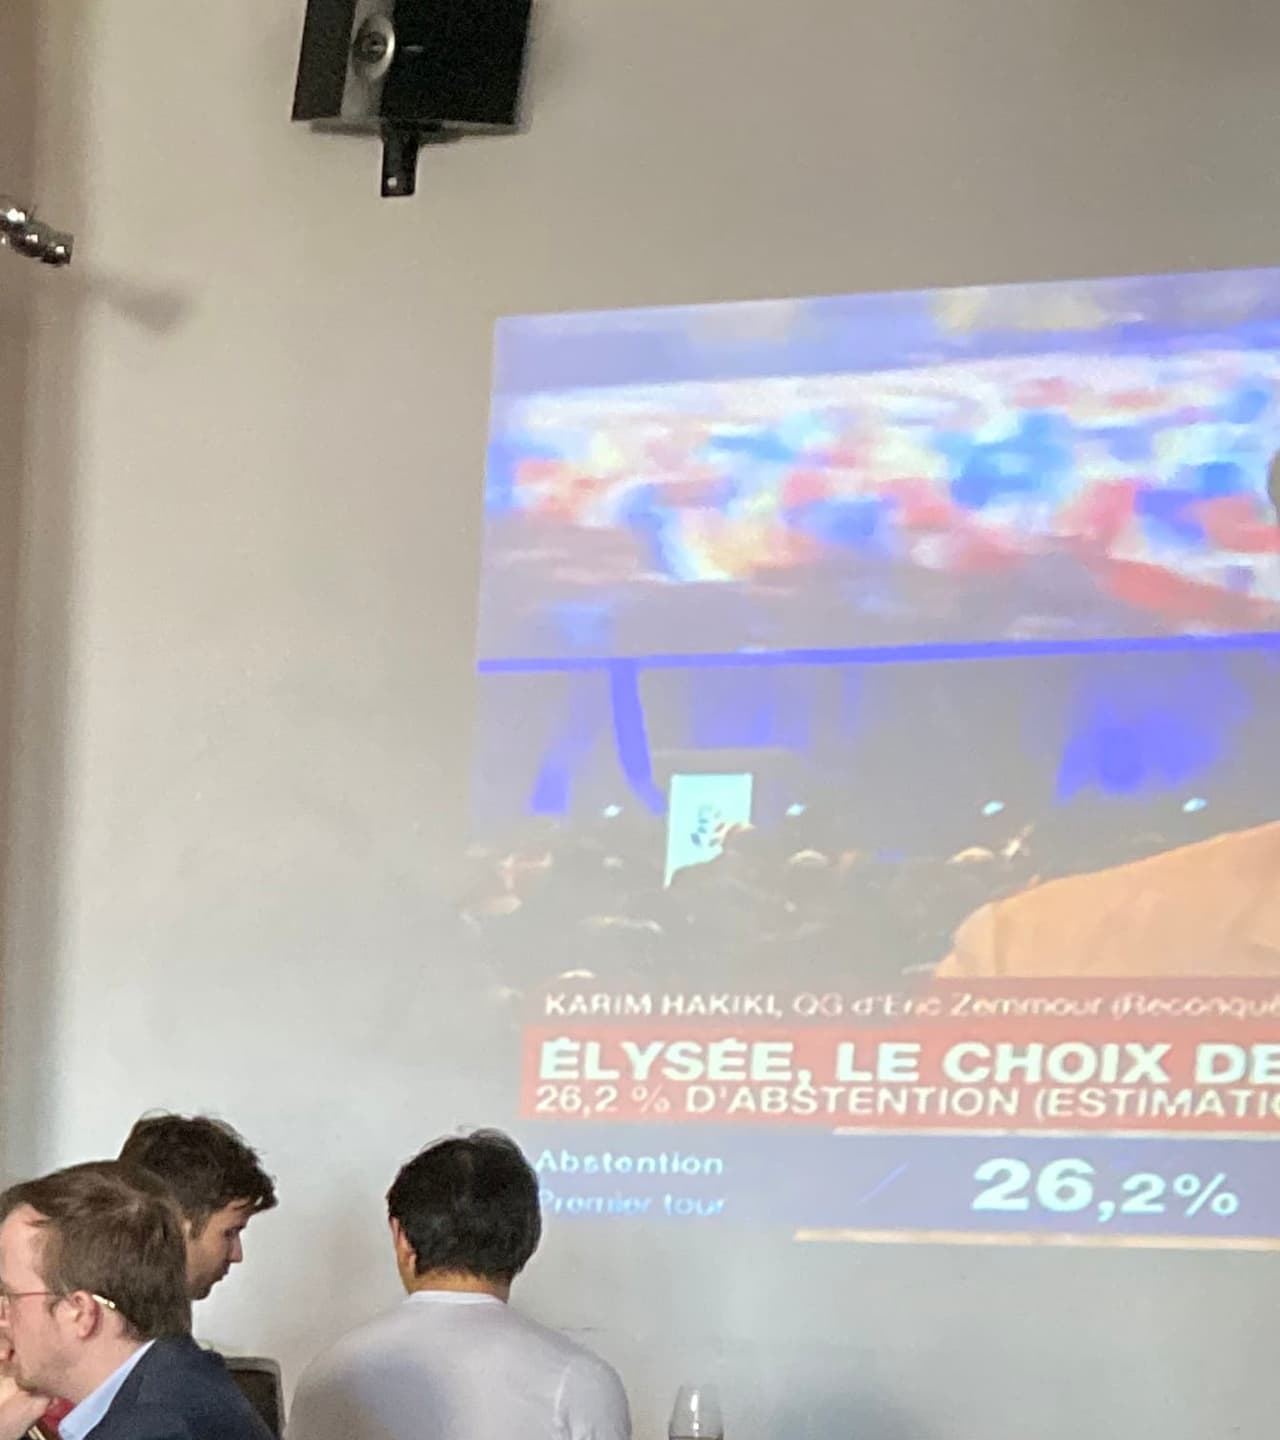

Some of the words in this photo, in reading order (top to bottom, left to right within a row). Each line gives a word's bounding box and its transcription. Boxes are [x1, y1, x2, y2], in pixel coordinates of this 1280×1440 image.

[545, 993, 653, 1016] KARIM
[660, 993, 784, 1018] HAKIKI,
[951, 992, 1103, 1016] Zemmour
[539, 1036, 813, 1090] ÉLYSÉE,
[835, 1042, 922, 1082] LE
[943, 1041, 1173, 1084] CHOIX
[535, 1085, 619, 1118] 26,2
[631, 1085, 672, 1113] %
[685, 1084, 1019, 1116] D'ABSTENTION
[535, 1149, 724, 1176] Abstention
[663, 1192, 726, 1216] tour
[971, 1157, 1239, 1223] 26,2%
